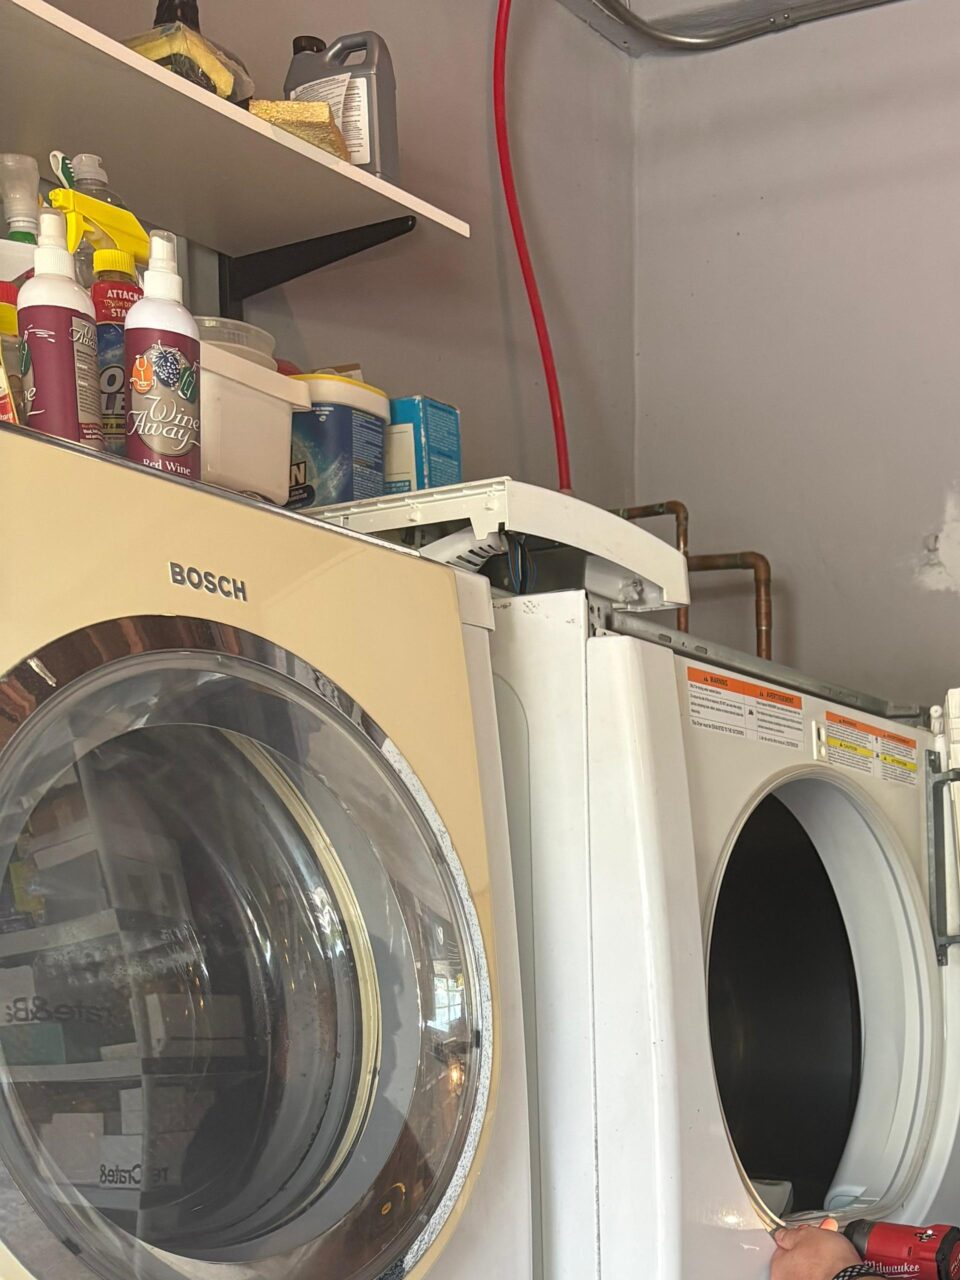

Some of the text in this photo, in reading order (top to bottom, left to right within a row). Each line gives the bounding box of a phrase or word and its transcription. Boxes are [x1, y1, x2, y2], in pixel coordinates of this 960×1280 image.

[111, 309, 127, 317] STA
[144, 395, 200, 431] Wine
[127, 410, 200, 450] Away
[143, 458, 191, 475] Red Wine
[168, 561, 248, 602] BOSCH
[863, 1259, 921, 1275] Milwaukee
